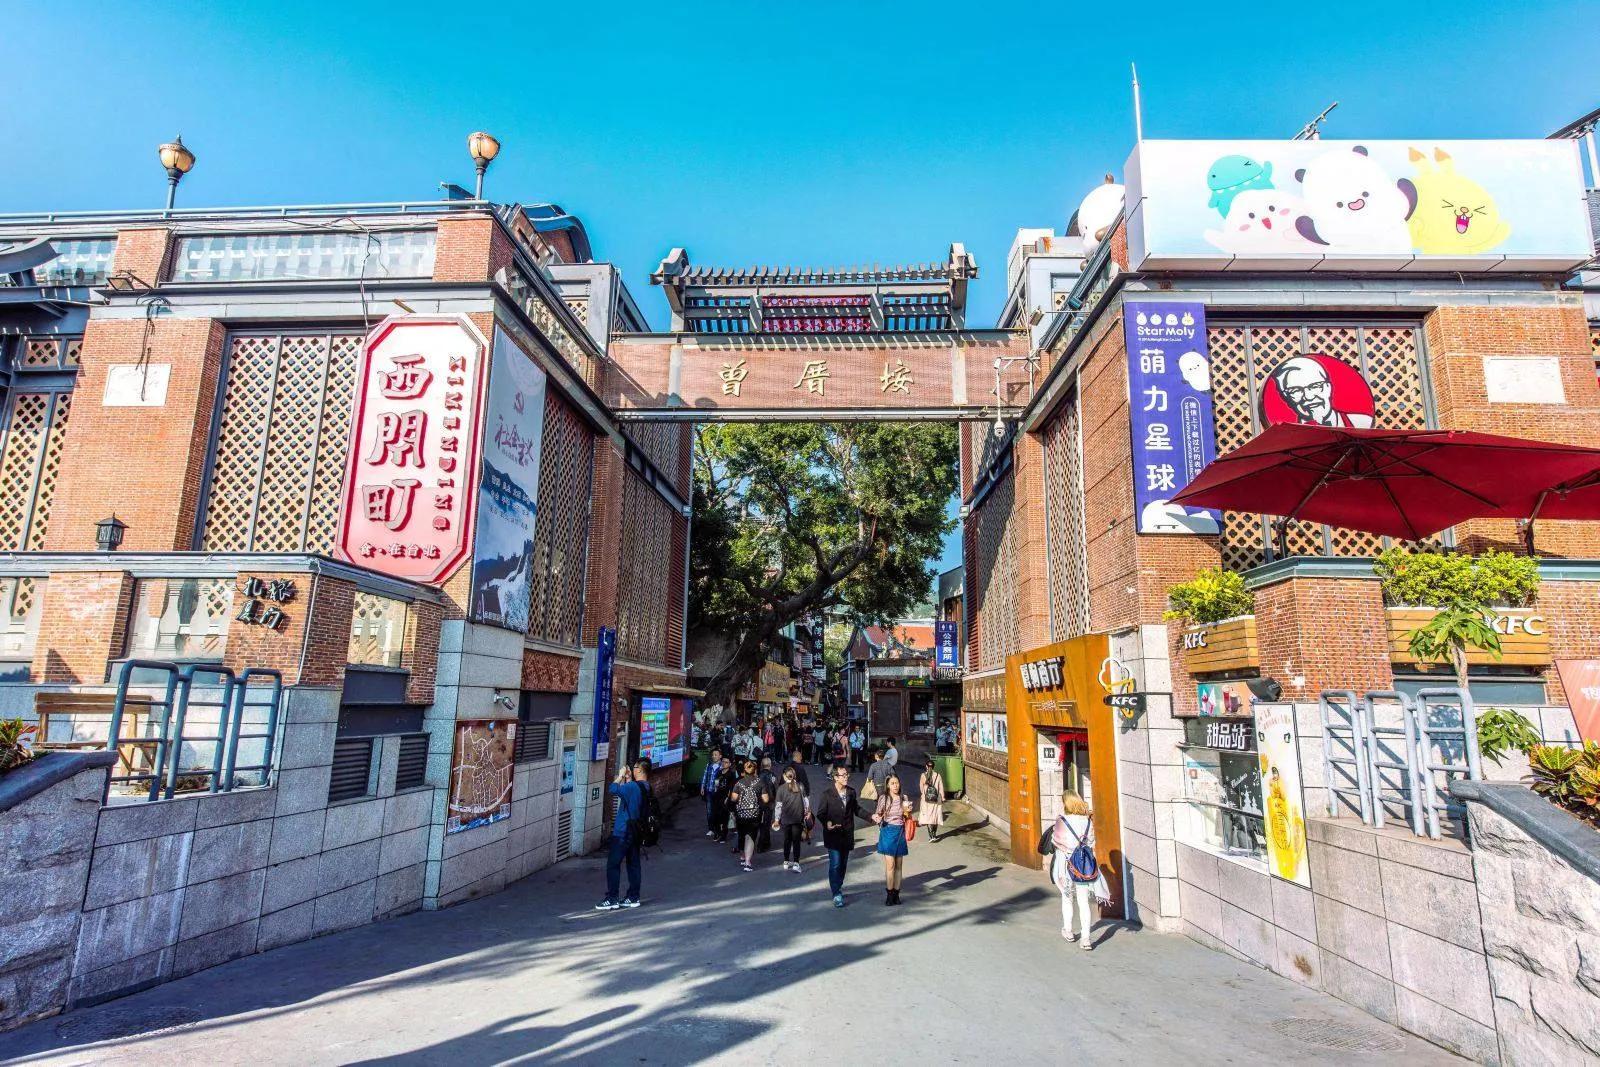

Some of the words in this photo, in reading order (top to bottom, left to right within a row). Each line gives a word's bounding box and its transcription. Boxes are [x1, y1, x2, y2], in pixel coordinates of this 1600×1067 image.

[1137, 326, 1164, 336] Star
[1165, 326, 1195, 339] Moly
[718, 358, 914, 397] 曾厝垵
[1140, 348, 1176, 491] 萌力星球
[432, 356, 467, 531] XIMENDING
[1485, 615, 1544, 636] KFC
[1184, 631, 1208, 650] KFC
[1111, 696, 1138, 706] KFC
[1206, 722, 1246, 750] 甜品站
